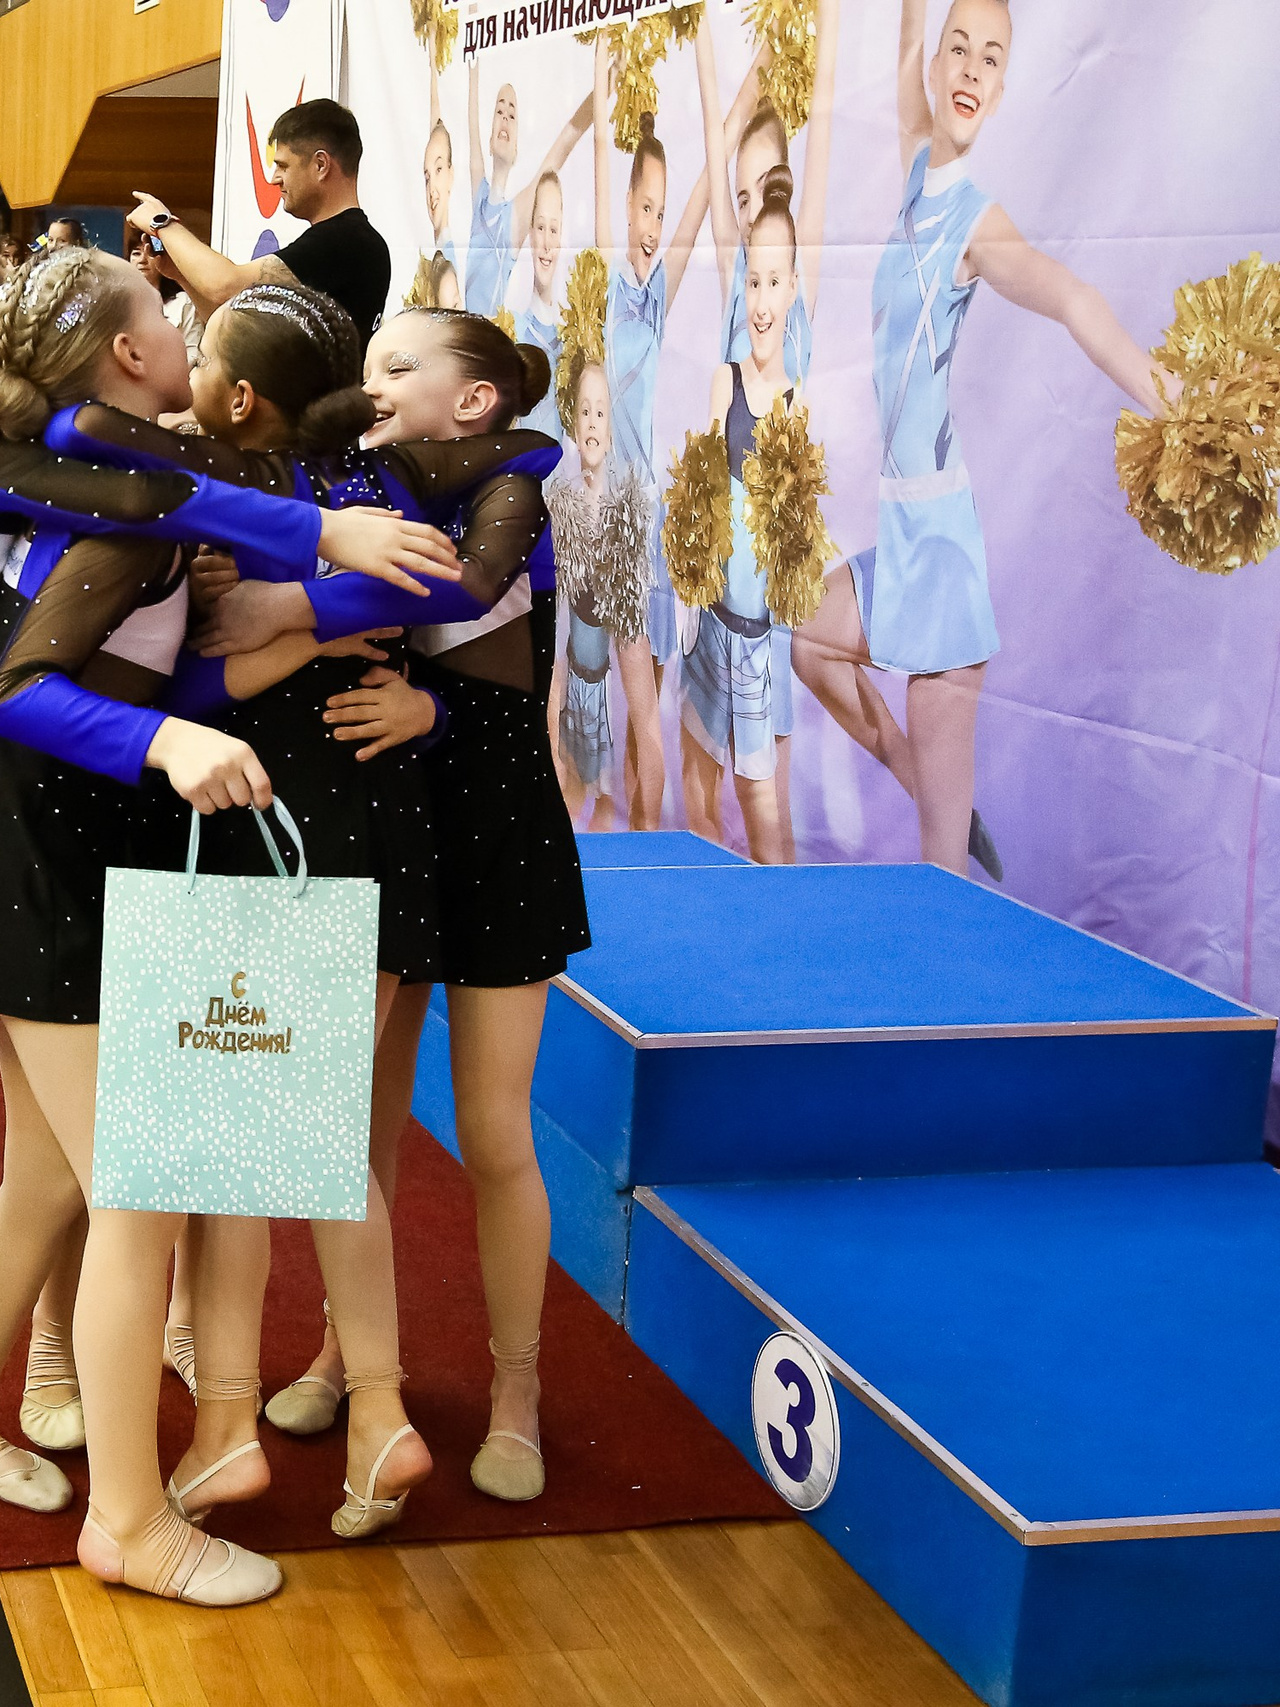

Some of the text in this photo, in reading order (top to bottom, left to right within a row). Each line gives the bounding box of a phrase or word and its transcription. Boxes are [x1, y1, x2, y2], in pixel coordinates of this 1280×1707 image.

[231, 971, 246, 999] С
[205, 997, 267, 1028] Днём
[178, 1021, 291, 1054] Рождения!
[767, 1358, 816, 1483] 3
